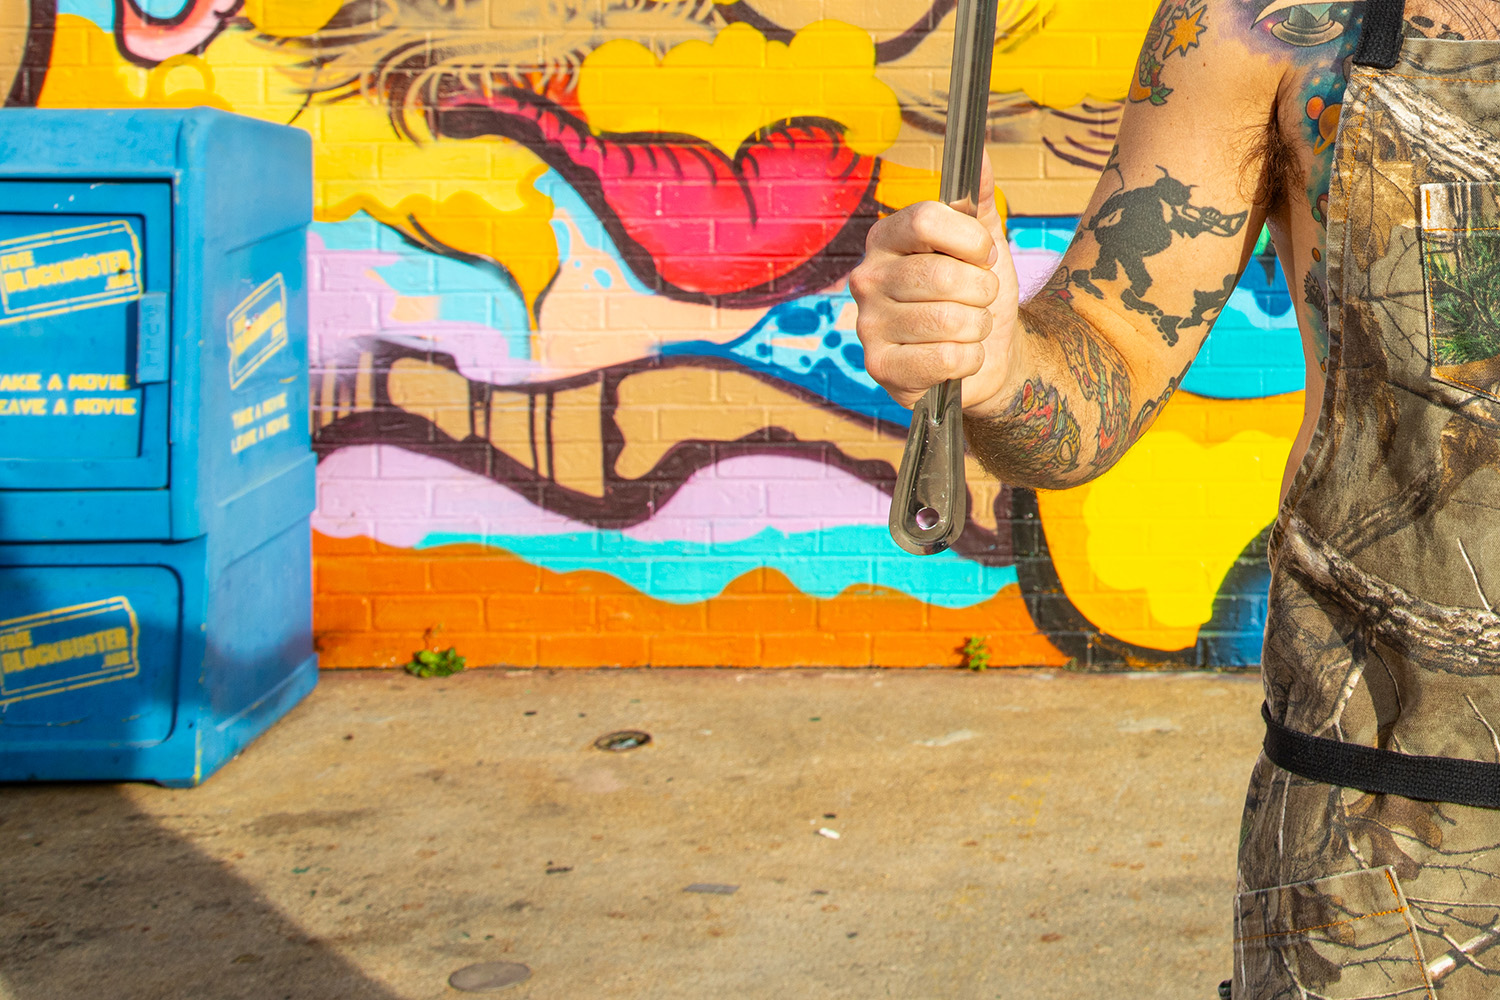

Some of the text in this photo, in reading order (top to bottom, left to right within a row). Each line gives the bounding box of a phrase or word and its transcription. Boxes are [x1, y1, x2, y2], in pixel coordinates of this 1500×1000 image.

[1, 250, 35, 271] FREE
[4, 249, 132, 293] BLOCKBUSTER
[0, 374, 130, 391] AKE A MOVIE
[0, 398, 136, 416] EAVE A MOVIE
[255, 403, 262, 420] A
[258, 426, 265, 441] A
[2, 627, 128, 674] BLOCKBUSTER
